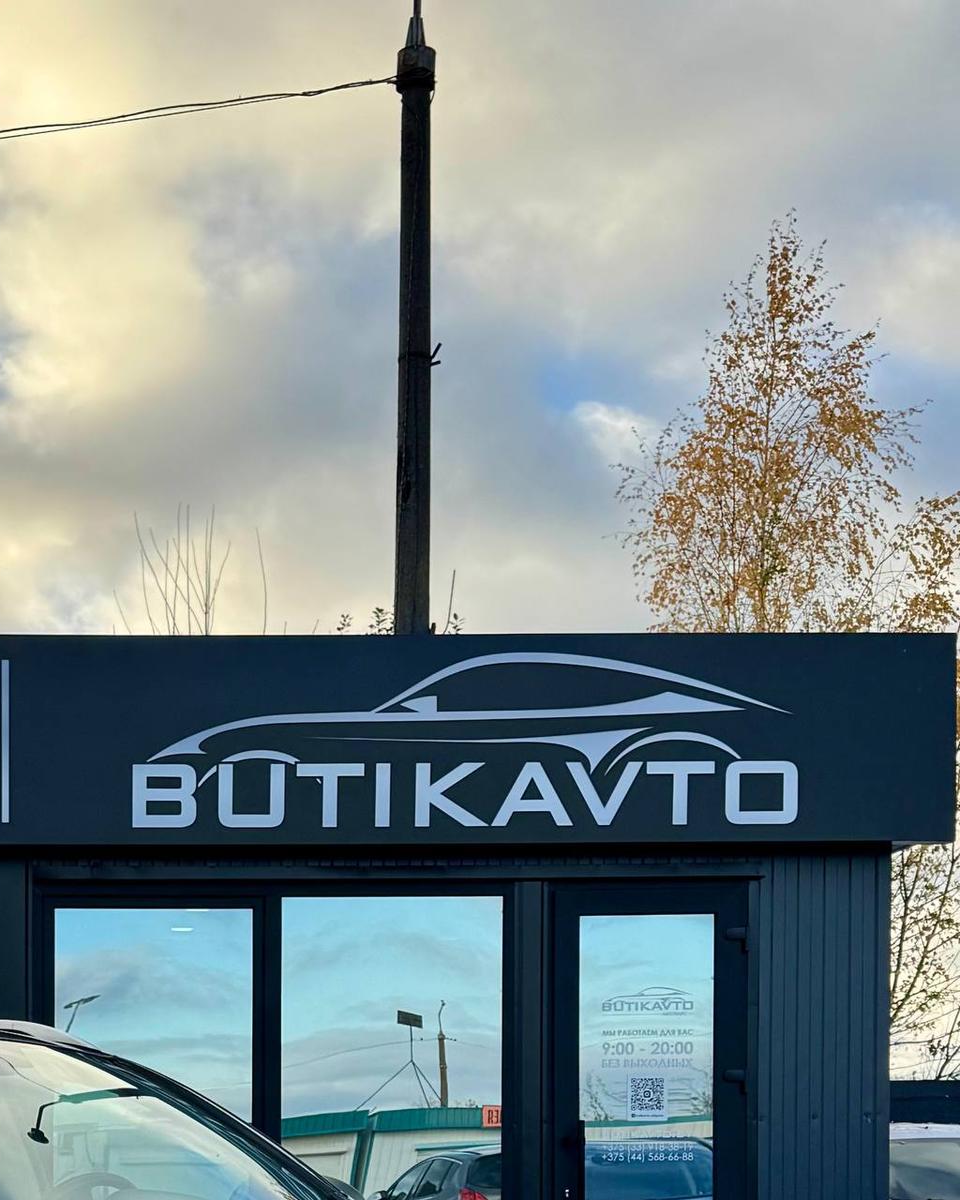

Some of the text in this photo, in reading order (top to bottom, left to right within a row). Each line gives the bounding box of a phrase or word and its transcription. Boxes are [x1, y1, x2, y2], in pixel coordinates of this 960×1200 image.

[131, 759, 799, 828] BUTIKAVTO
[602, 1001, 694, 1012] BUTIKAVTO
[602, 1042, 635, 1055] 9:00
[650, 1041, 694, 1055] 20:00
[601, 1153, 694, 1163] +375 (44) 568-66-88
